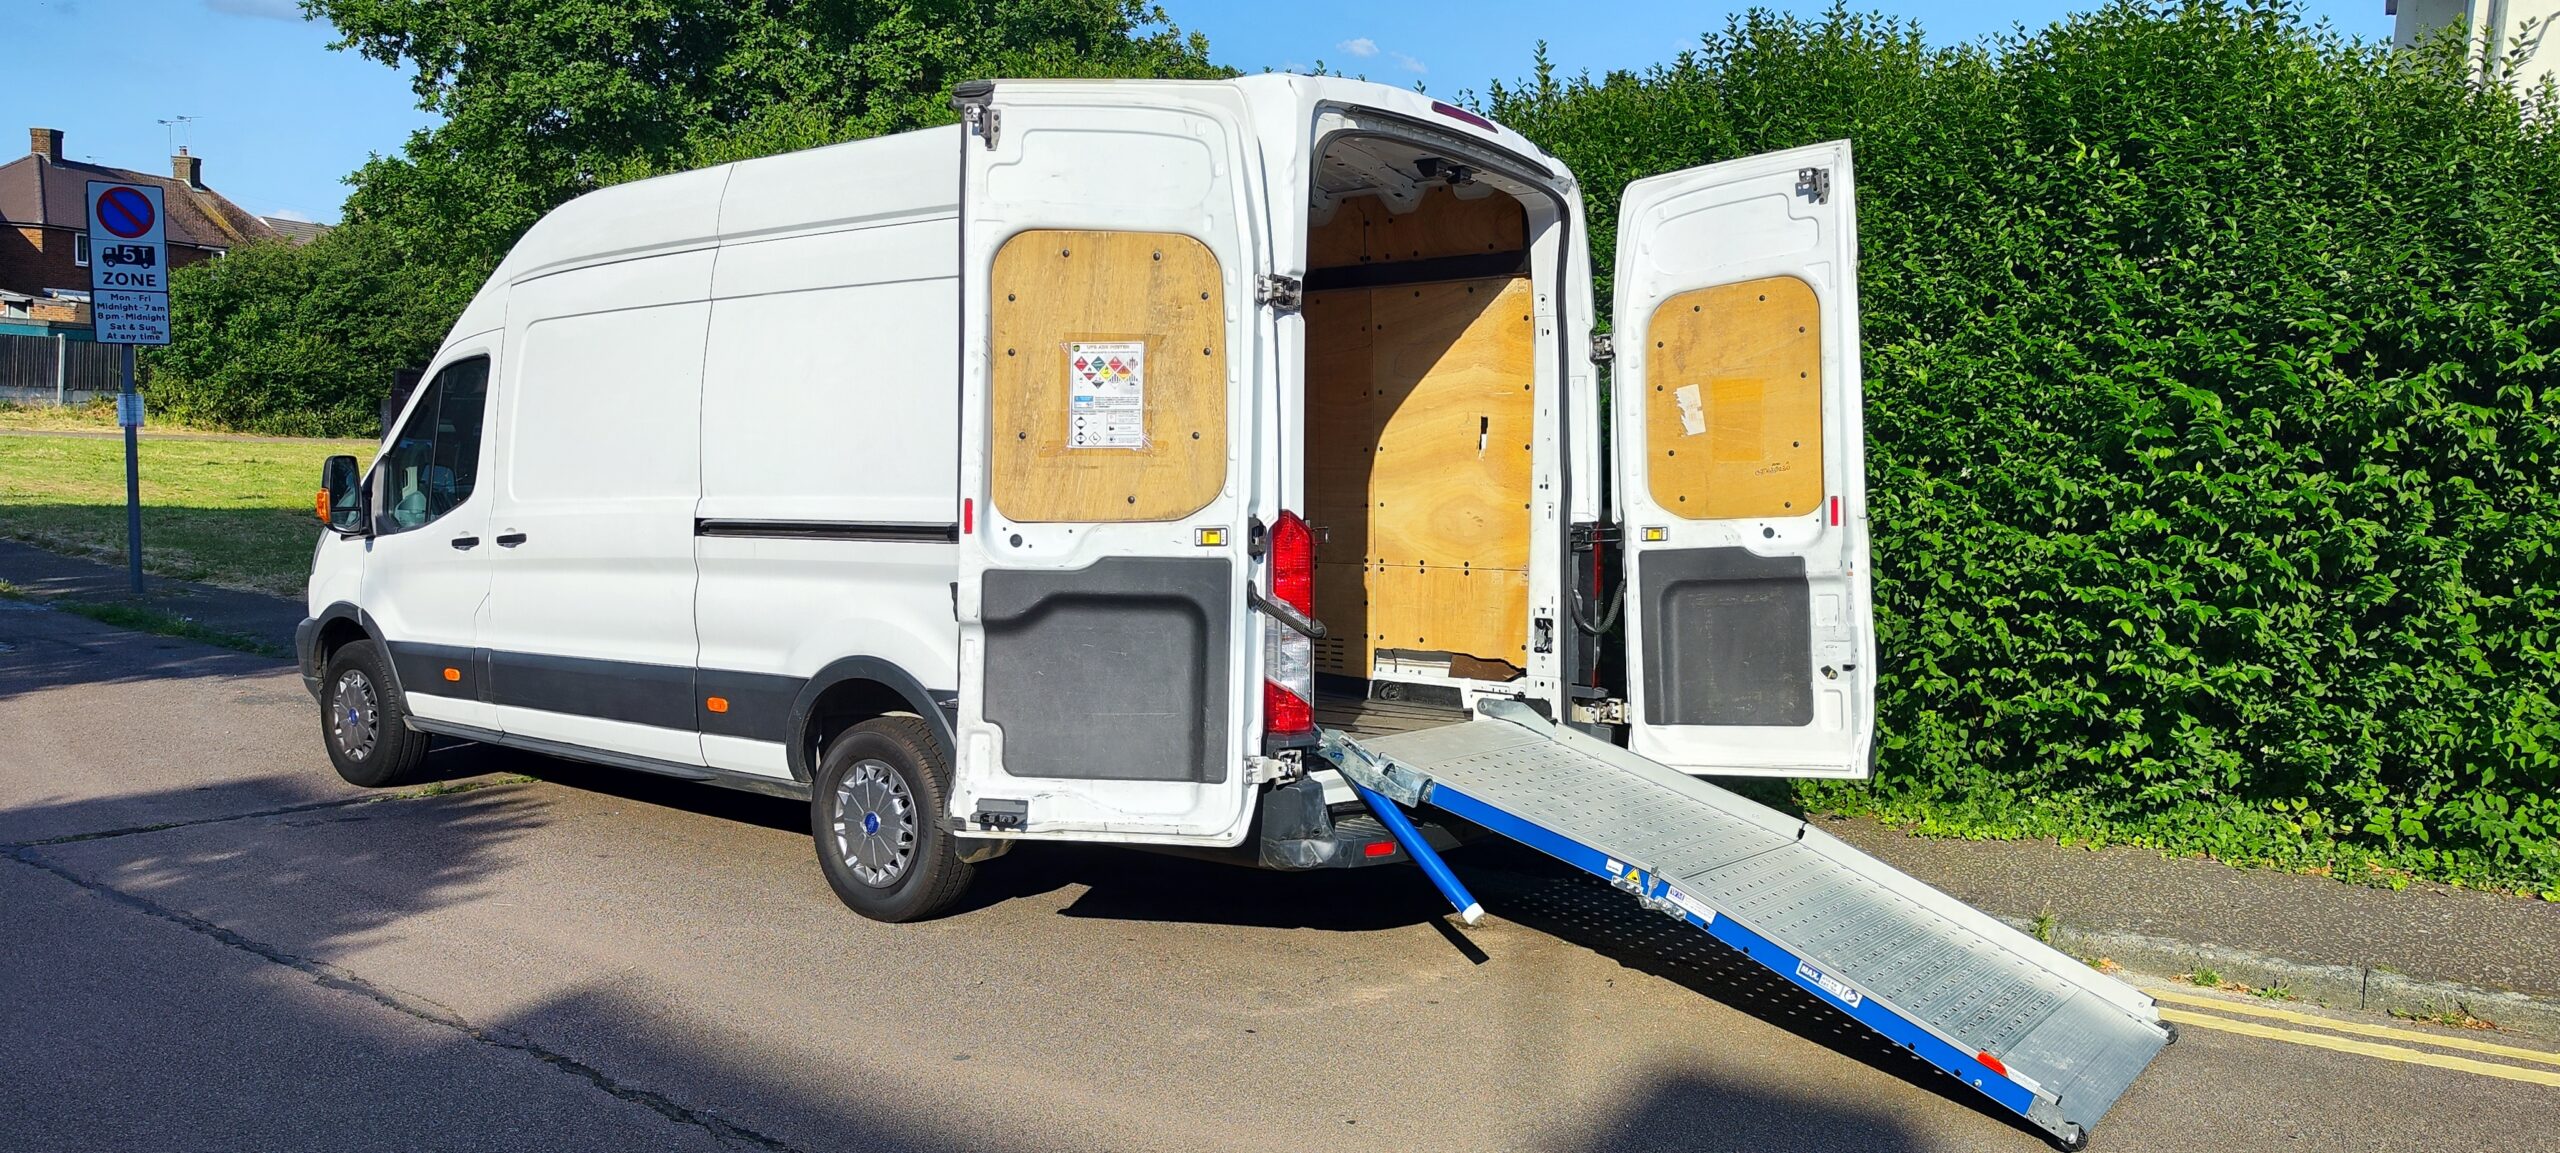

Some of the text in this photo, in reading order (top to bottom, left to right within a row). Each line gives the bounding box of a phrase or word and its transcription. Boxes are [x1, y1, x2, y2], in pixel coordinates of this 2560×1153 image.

[102, 271, 156, 287] ZONE
[110, 293, 131, 301] Mon
[138, 294, 151, 302] Fri
[97, 302, 138, 312] Midnight
[125, 313, 166, 322] Midnight
[110, 322, 157, 332] Sat & Sun
[106, 332, 118, 340] At
[120, 333, 137, 341] any
[139, 332, 161, 341] time
